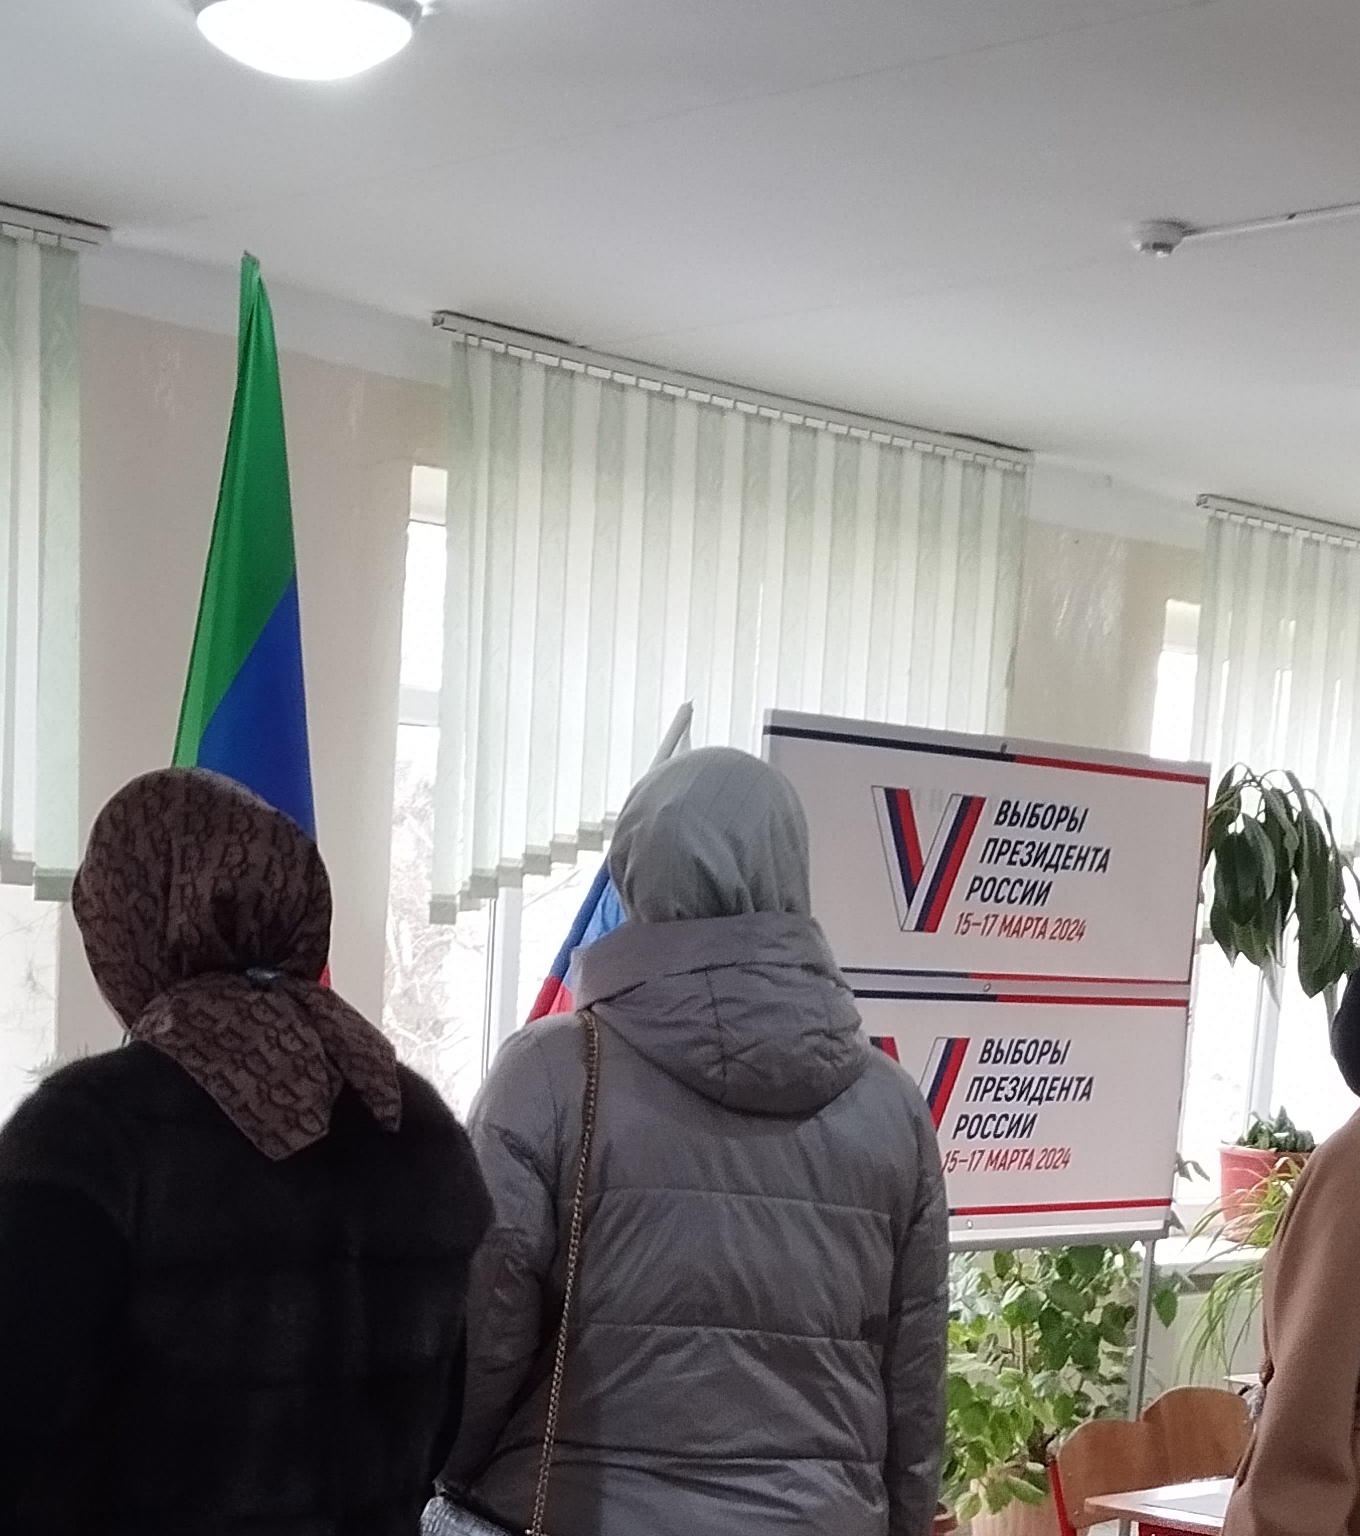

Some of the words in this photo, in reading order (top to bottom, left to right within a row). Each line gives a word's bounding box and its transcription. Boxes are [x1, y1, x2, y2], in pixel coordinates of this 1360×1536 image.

[994, 800, 1089, 833] ВЫБОРЫ
[979, 837, 1112, 874] ПРЕЗИДЕНТА
[964, 875, 1053, 907] РОССИИ
[998, 914, 1047, 940] МАРТА
[1049, 917, 1086, 942] 2024
[978, 1038, 1072, 1065] ВЫБОРЫ
[965, 1076, 1094, 1106] ПРЕЗИДЕНТА
[951, 1112, 1038, 1140] РОССИИ
[984, 1148, 1035, 1172] МАРТА
[1035, 1147, 1072, 1171] 2024
